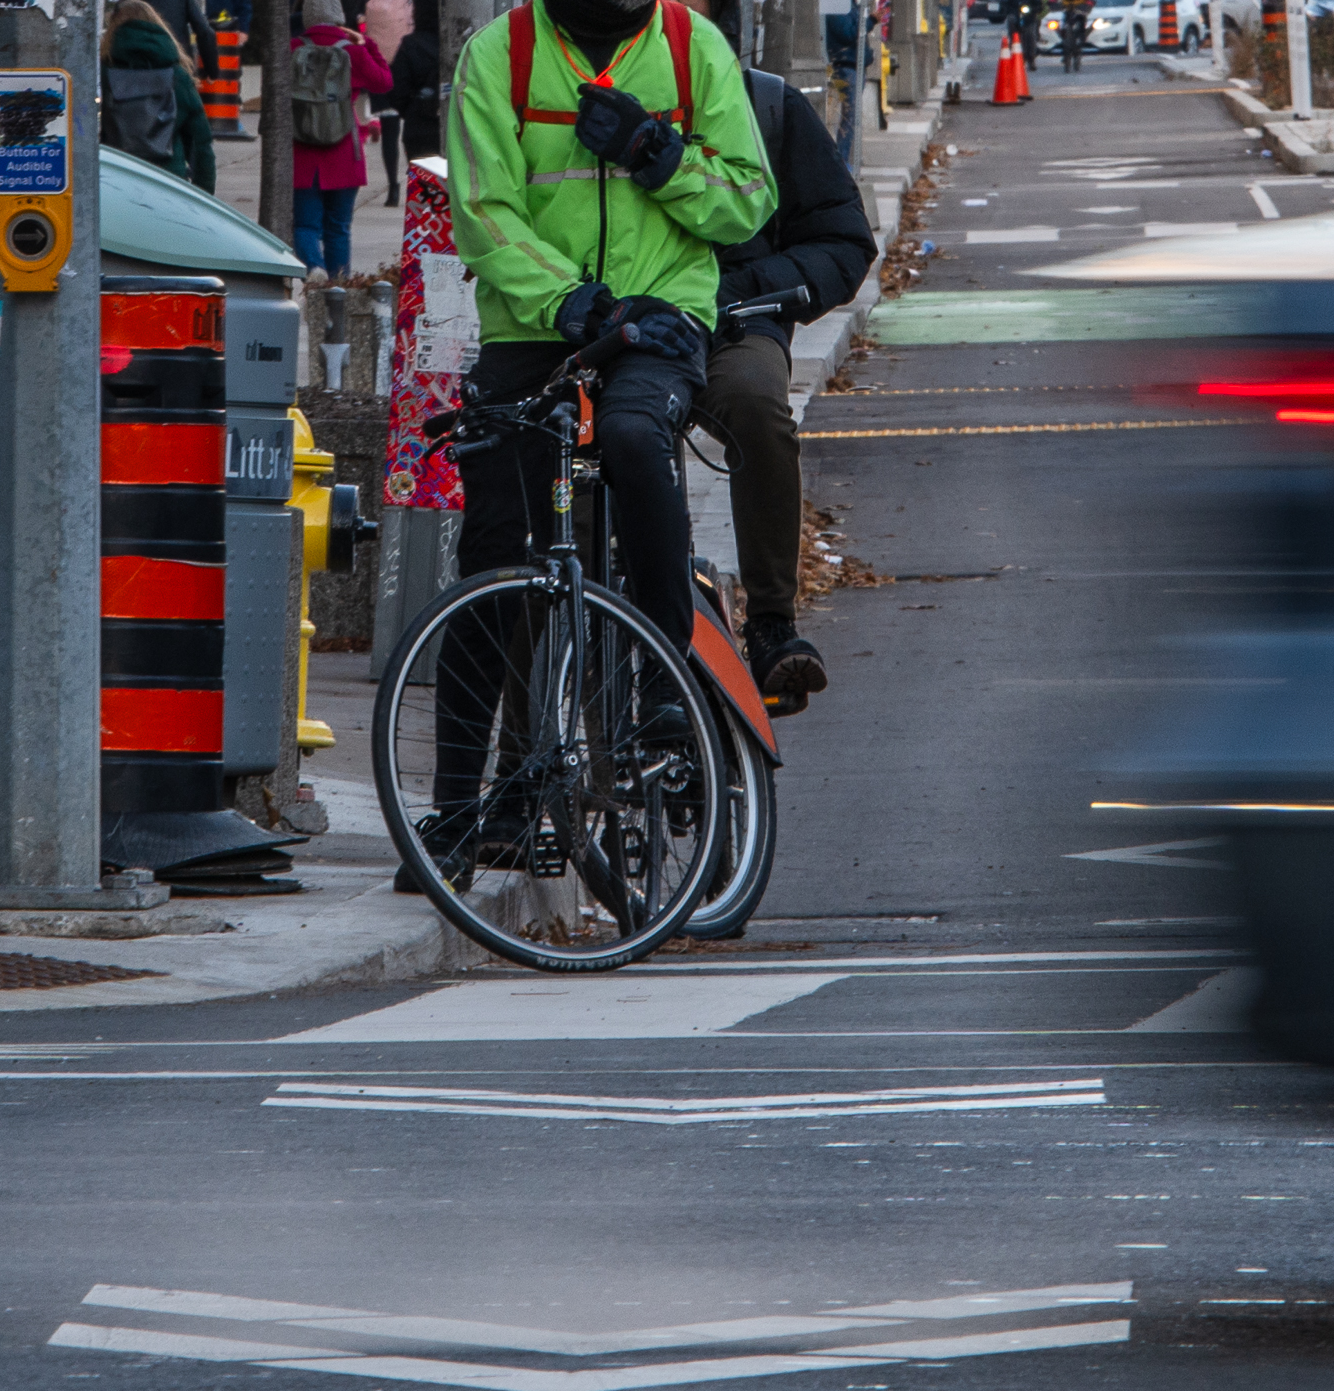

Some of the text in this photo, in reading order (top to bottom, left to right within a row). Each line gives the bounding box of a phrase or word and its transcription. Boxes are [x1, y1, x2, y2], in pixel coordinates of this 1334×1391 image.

[41, 147, 61, 157] For
[6, 161, 53, 171] Audible
[35, 175, 62, 187] Only
